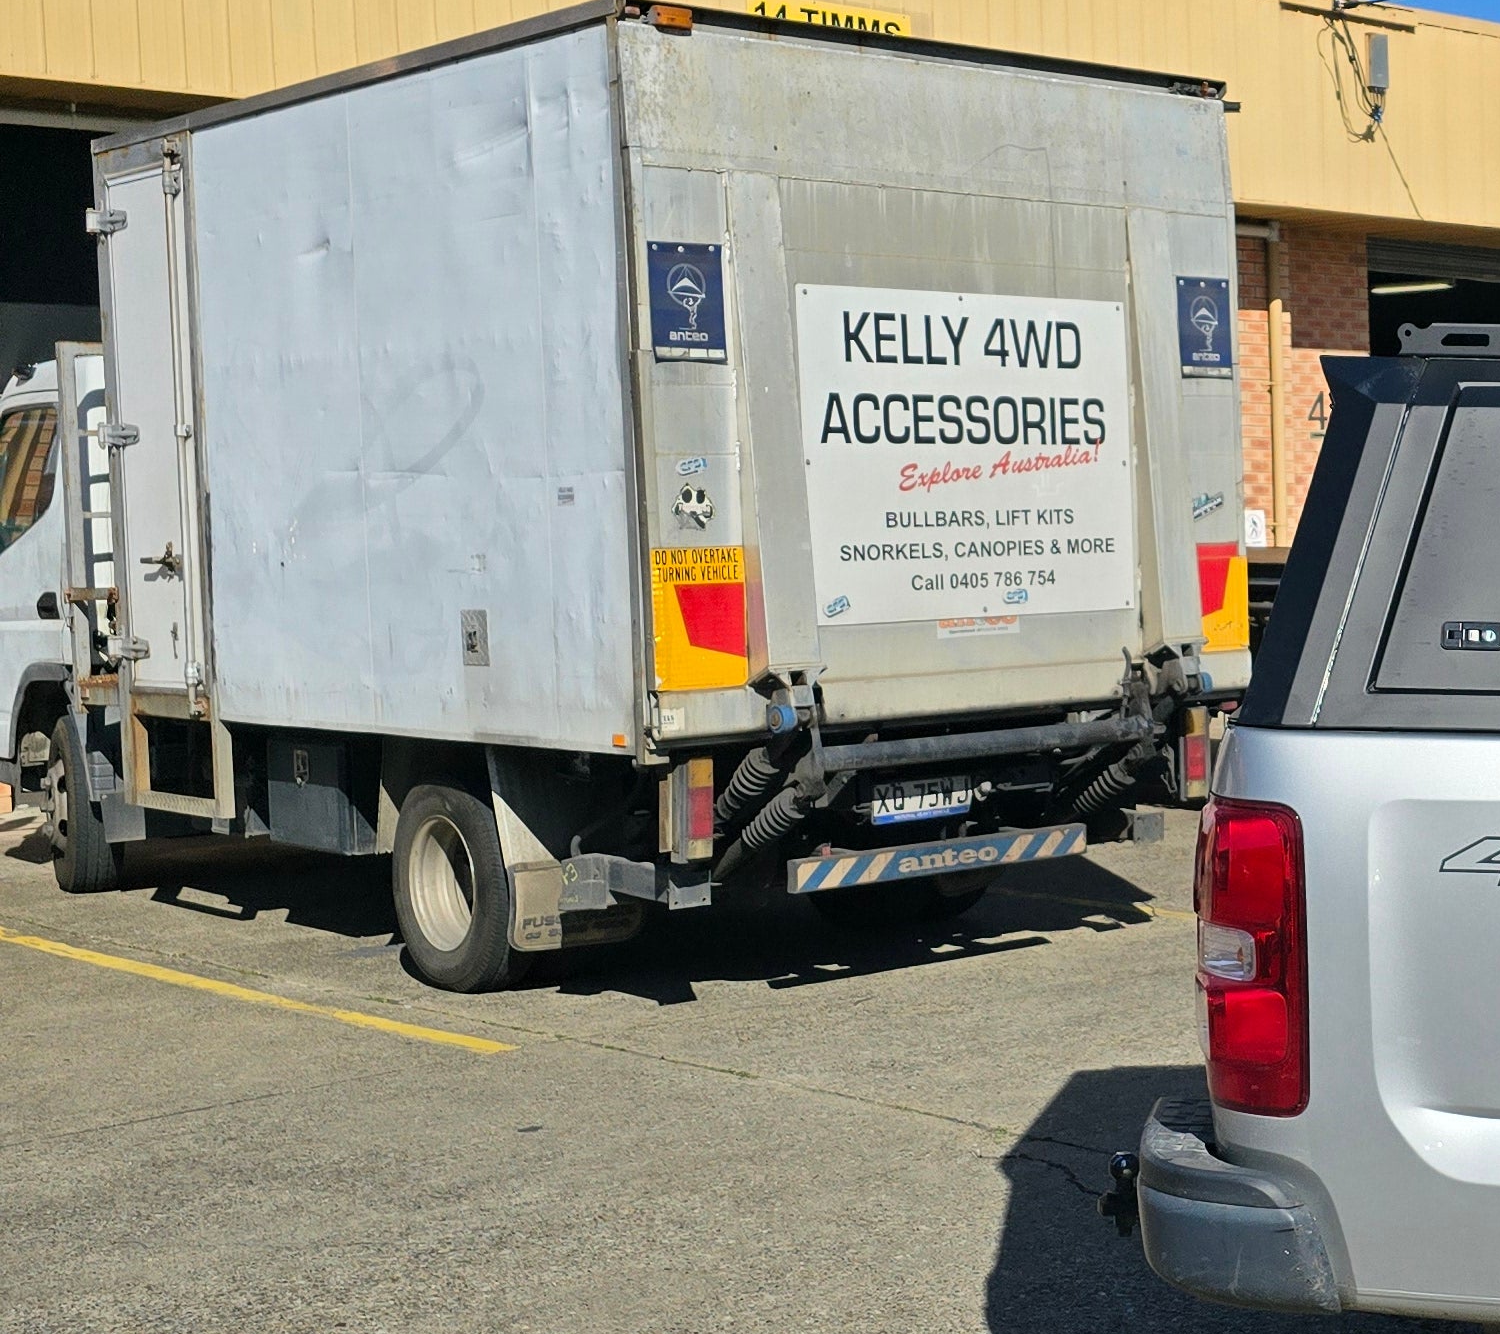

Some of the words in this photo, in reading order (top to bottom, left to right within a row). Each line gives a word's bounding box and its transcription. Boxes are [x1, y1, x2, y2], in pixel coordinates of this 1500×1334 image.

[669, 330, 709, 342] anteo
[843, 310, 970, 366] KELLY
[983, 317, 1082, 369] 4WD
[820, 392, 1107, 445] ACCESSORIES
[1307, 390, 1328, 430] 4
[899, 461, 983, 492] Explore
[989, 438, 1102, 479] Australia!
[885, 510, 991, 530] BULLBARS,
[995, 509, 1032, 527] LIFT
[1037, 508, 1075, 525] KITS
[655, 550, 667, 566] DO
[671, 549, 688, 565] NOT
[691, 548, 739, 565] OVERTAKE
[840, 542, 949, 562] SNORKELS,
[954, 540, 1045, 558] CANOPIES
[1050, 539, 1062, 555] &
[1067, 538, 1116, 554] MORE
[658, 567, 697, 583] TURNING
[700, 565, 739, 581] VEHICLE
[911, 573, 944, 591] Call
[950, 572, 989, 589] 0405
[995, 571, 1023, 587] 786
[1029, 569, 1056, 585] 754
[898, 846, 999, 873] anteo
